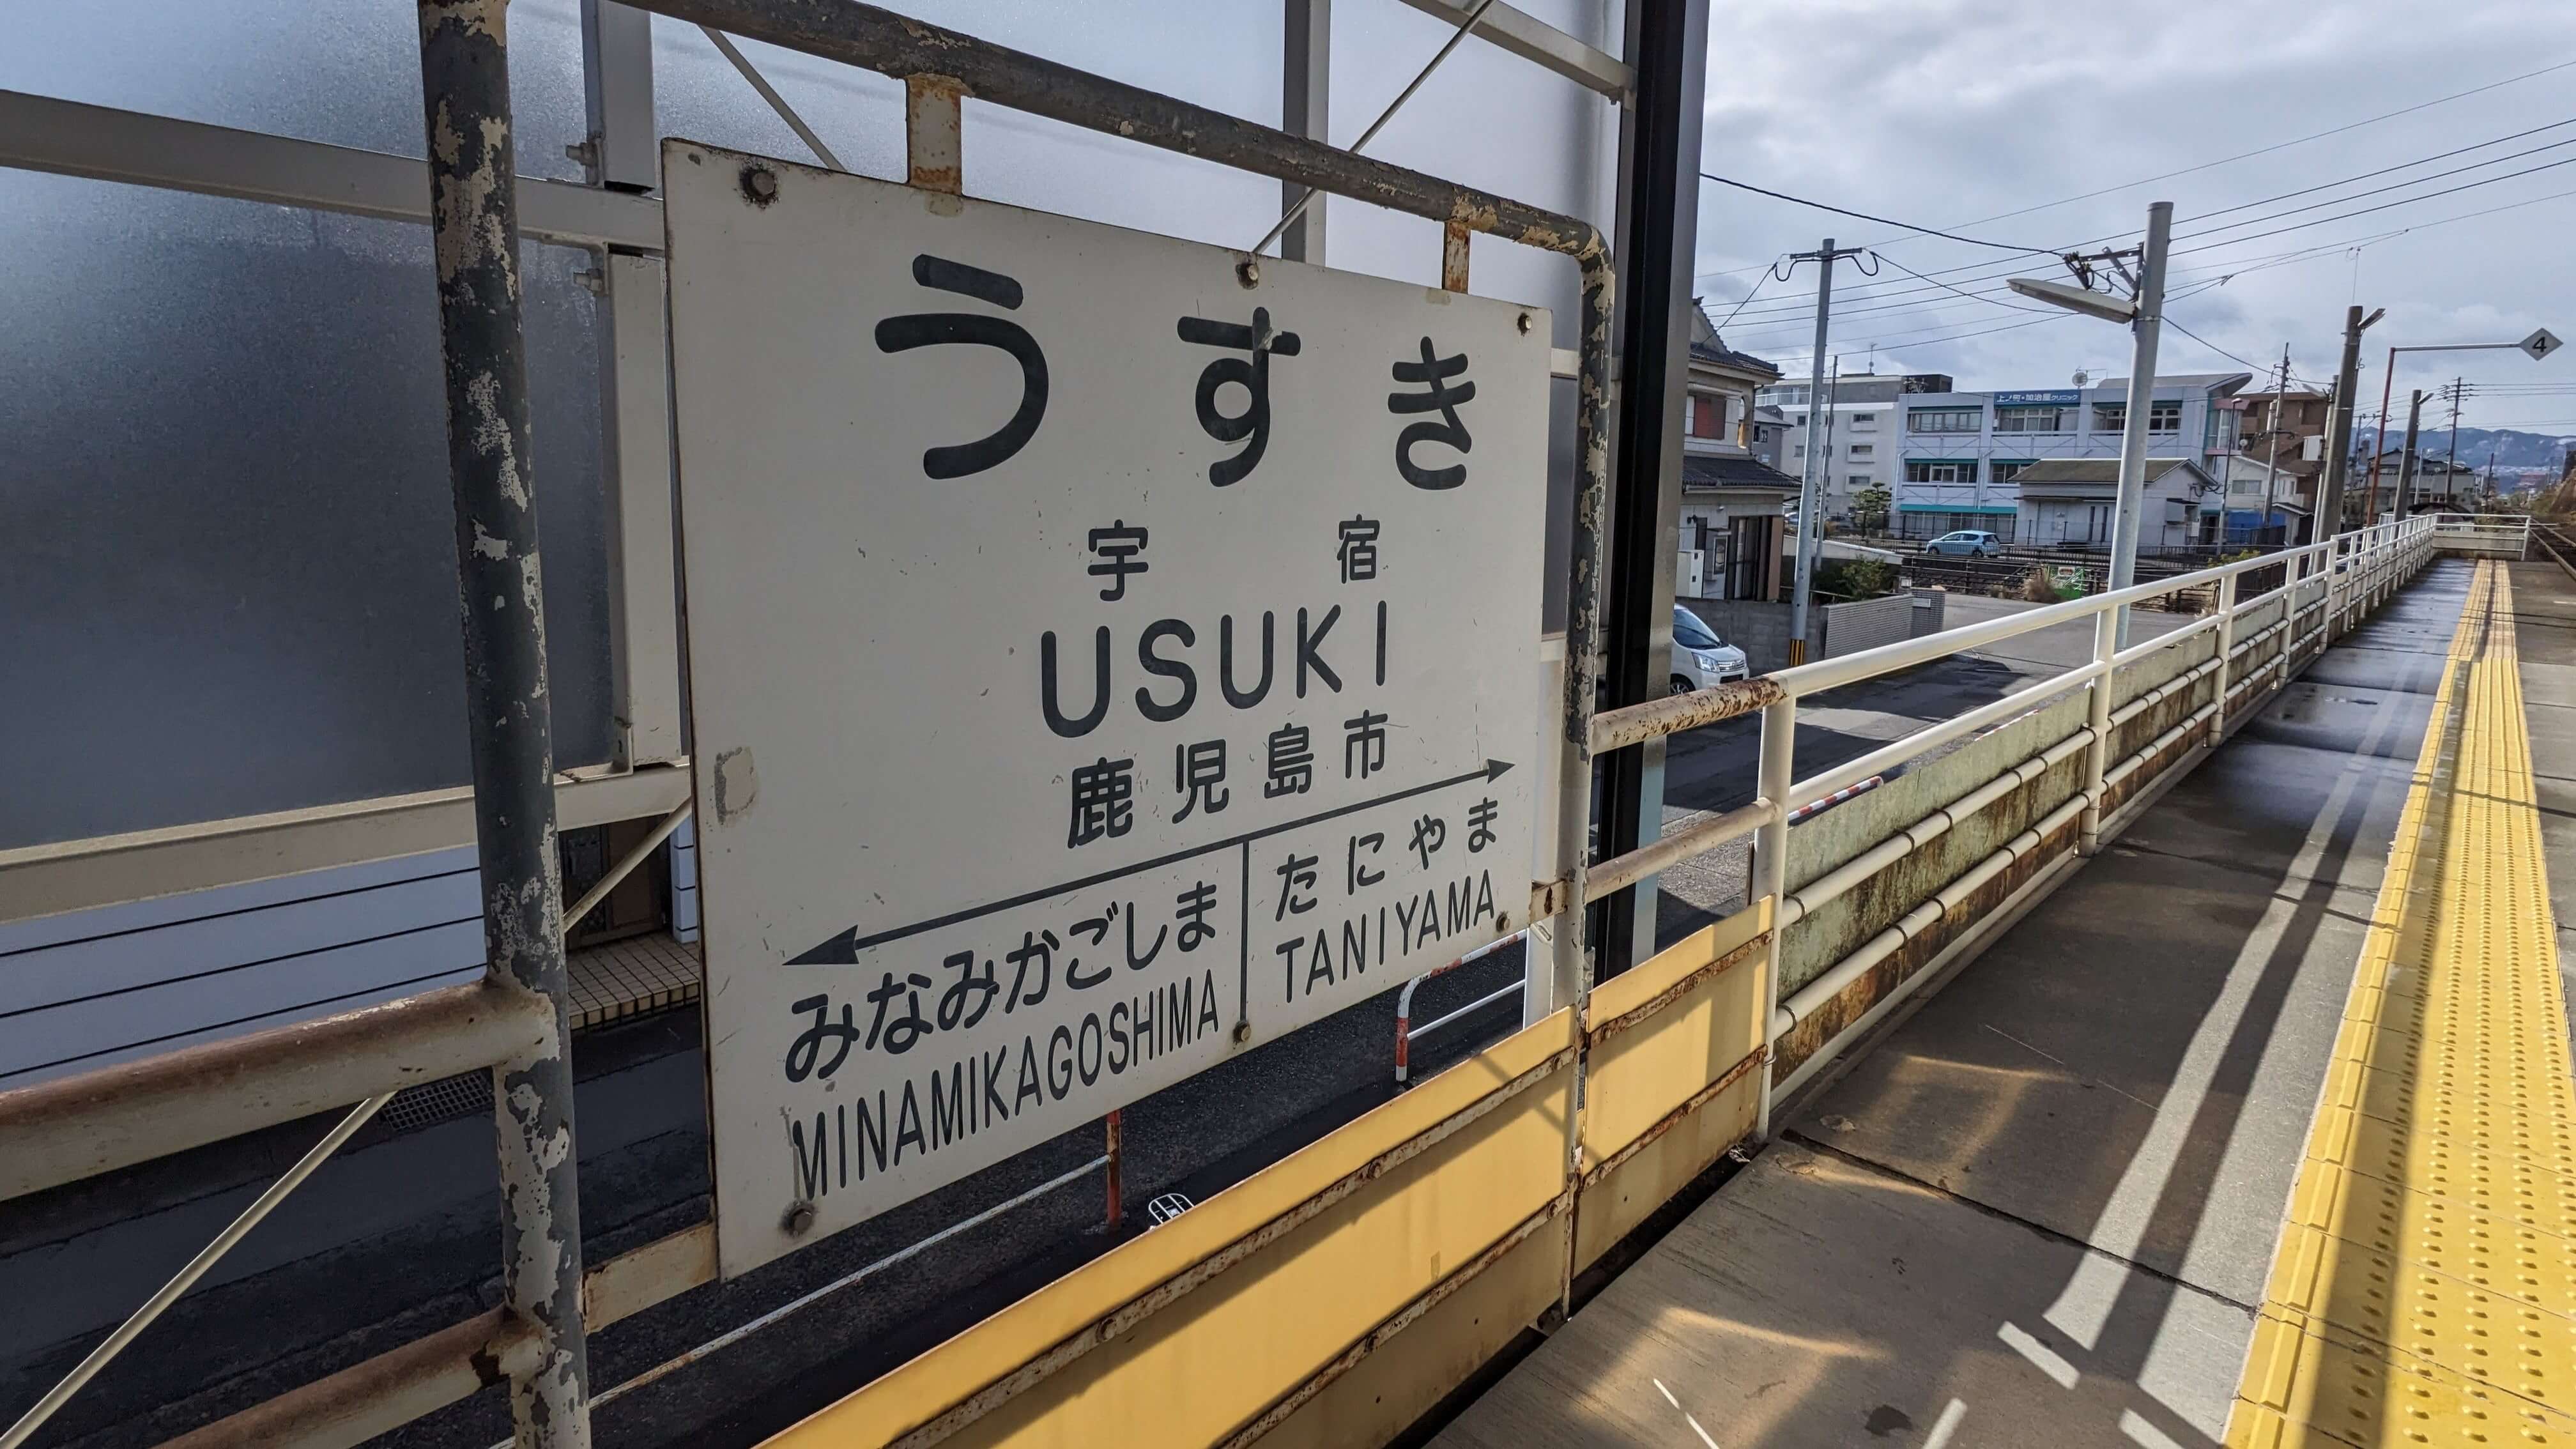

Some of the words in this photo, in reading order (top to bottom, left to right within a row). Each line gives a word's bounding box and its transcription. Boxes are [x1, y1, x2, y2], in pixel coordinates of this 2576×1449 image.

[875, 253, 1475, 490] うすき
[2532, 337, 2547, 353] 4
[1088, 514, 1379, 601] 宇宿
[1041, 601, 1386, 738] USUKI
[1068, 710, 1388, 848] 鹿児島市
[1276, 797, 1498, 921] たにやま
[785, 881, 1216, 1082] みなみかごしま
[1276, 870, 1494, 1003] TANIYAMA
[793, 969, 1218, 1200] MINAMIKAGOSHIMA
